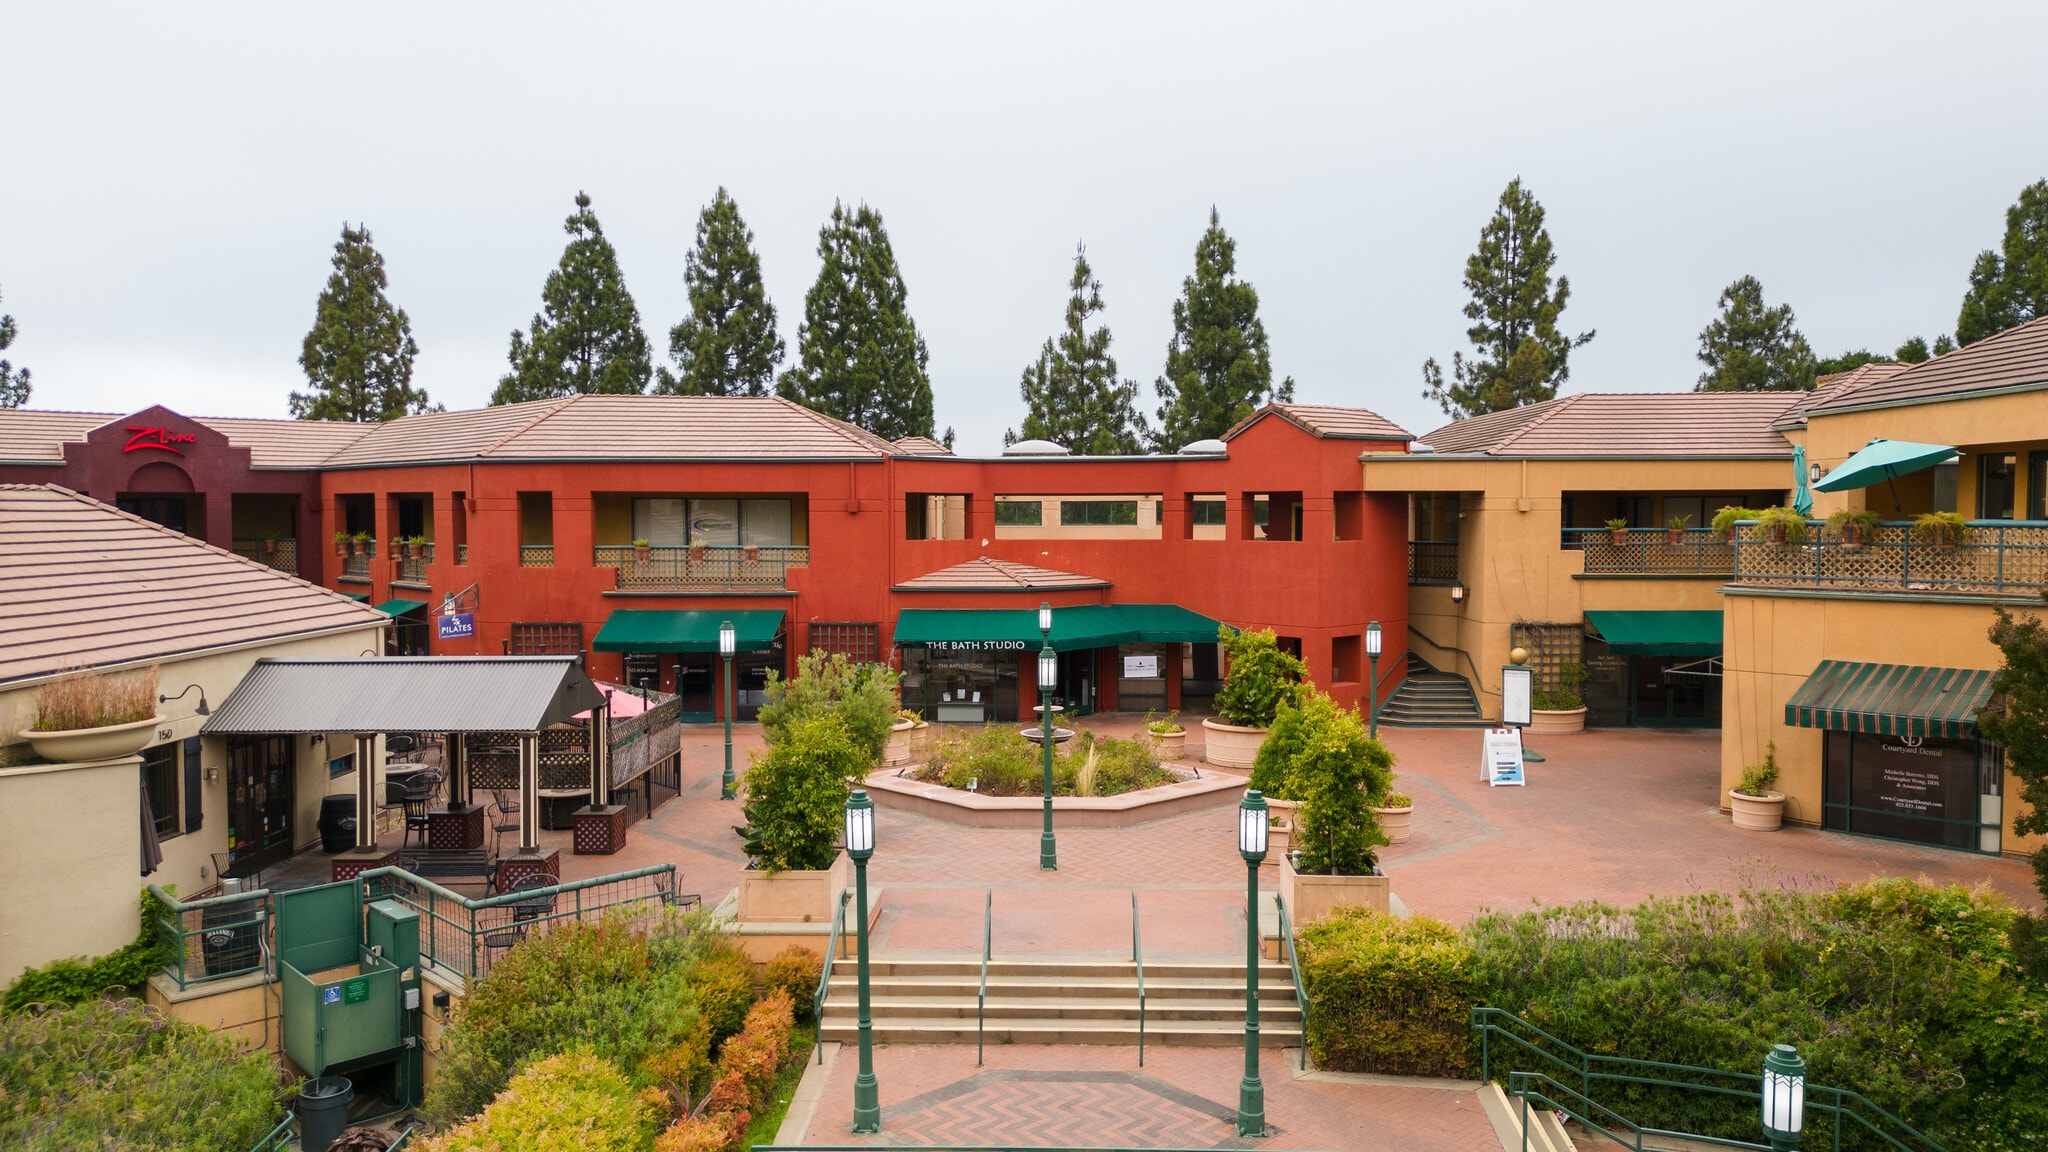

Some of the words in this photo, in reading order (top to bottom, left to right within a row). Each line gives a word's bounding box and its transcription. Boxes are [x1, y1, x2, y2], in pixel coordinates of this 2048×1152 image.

[441, 624, 472, 634] PILATES
[926, 641, 948, 650] THE
[951, 641, 980, 650] BATH
[983, 640, 1025, 650] STUDIO
[158, 729, 173, 740] 150
[1882, 743, 1918, 754] Courtyard
[1919, 748, 1943, 757] Dental
